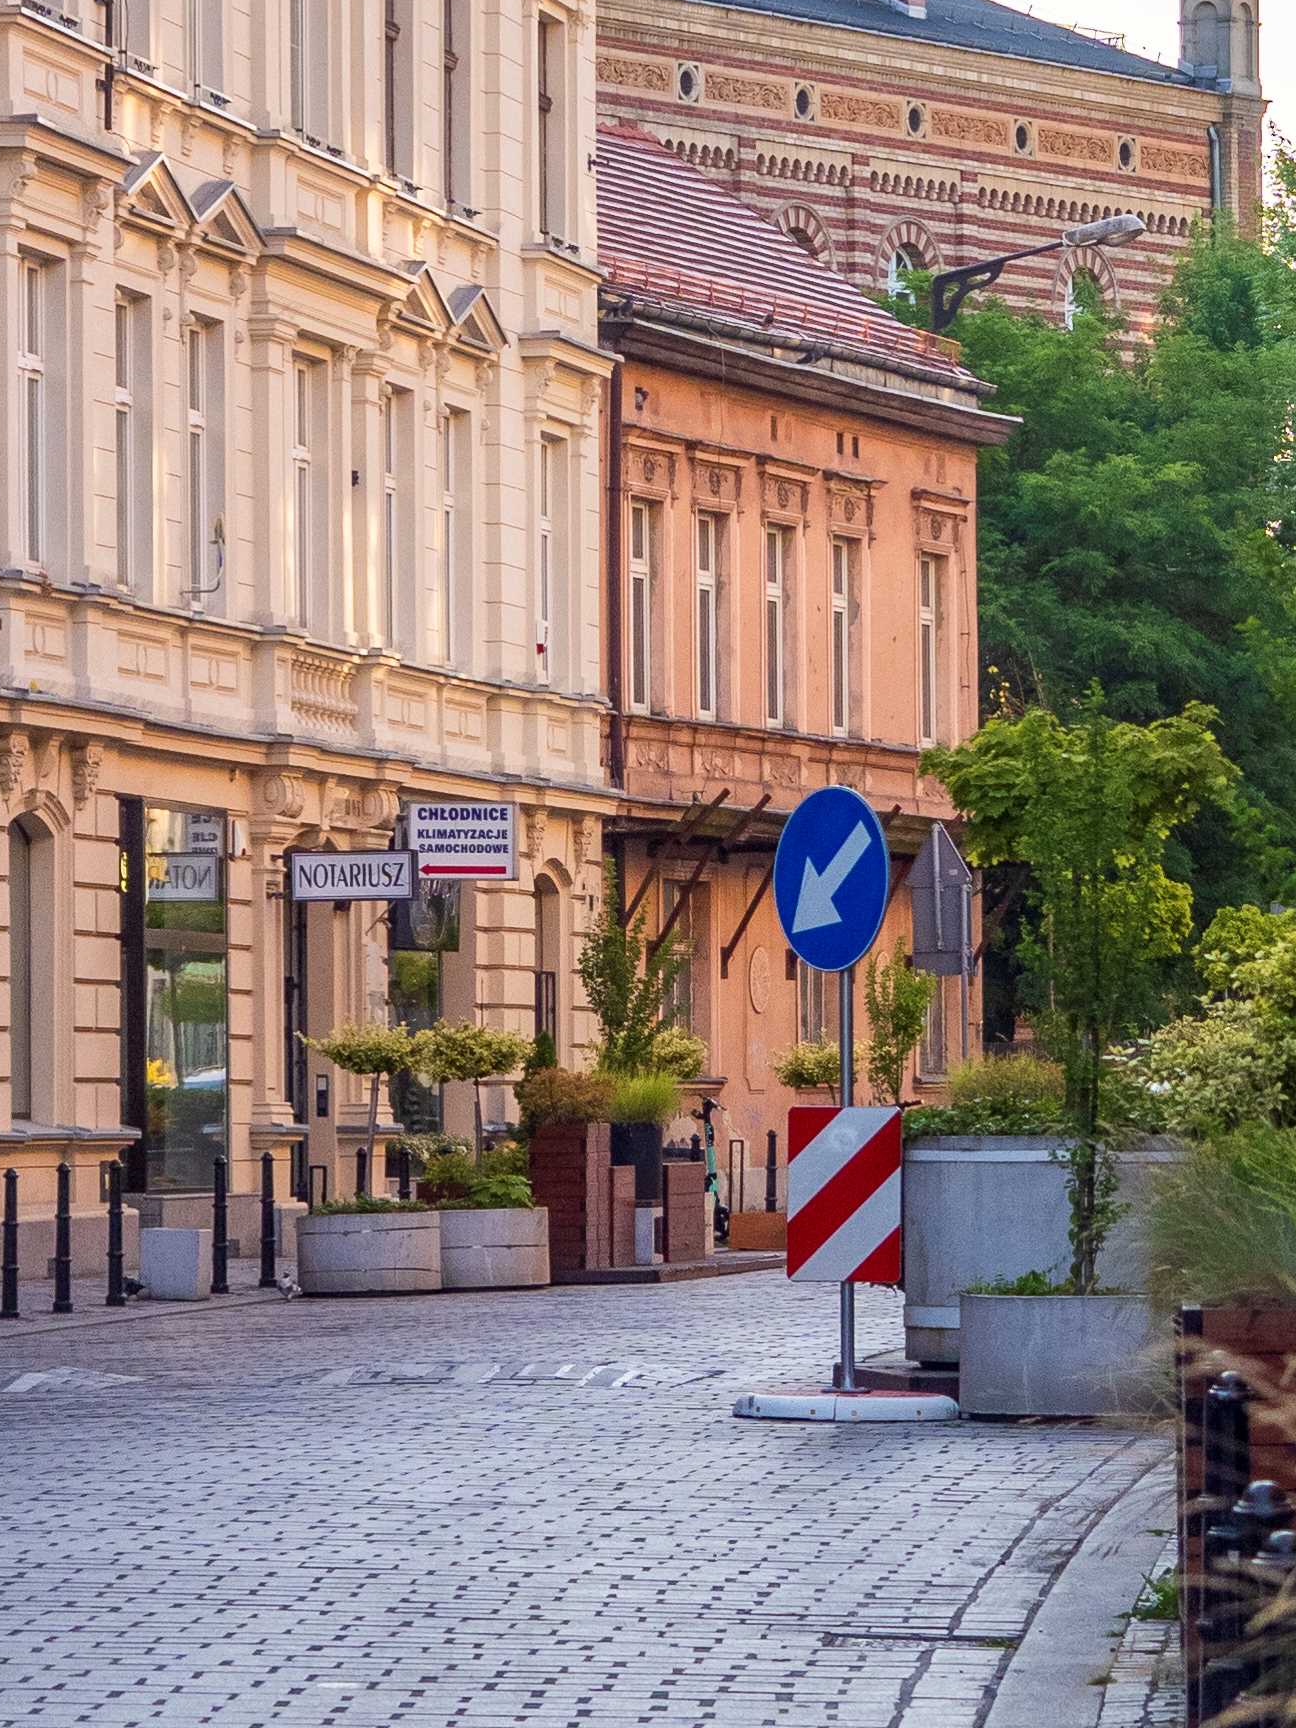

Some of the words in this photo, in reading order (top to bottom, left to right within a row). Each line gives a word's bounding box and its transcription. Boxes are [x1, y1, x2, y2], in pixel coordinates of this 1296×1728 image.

[417, 807, 509, 822] CHŁODNICE
[417, 828, 508, 840] KLIMATYZACJE
[418, 843, 509, 854] SAMOCHODOWE
[298, 862, 405, 889] NOTARIUSZ
